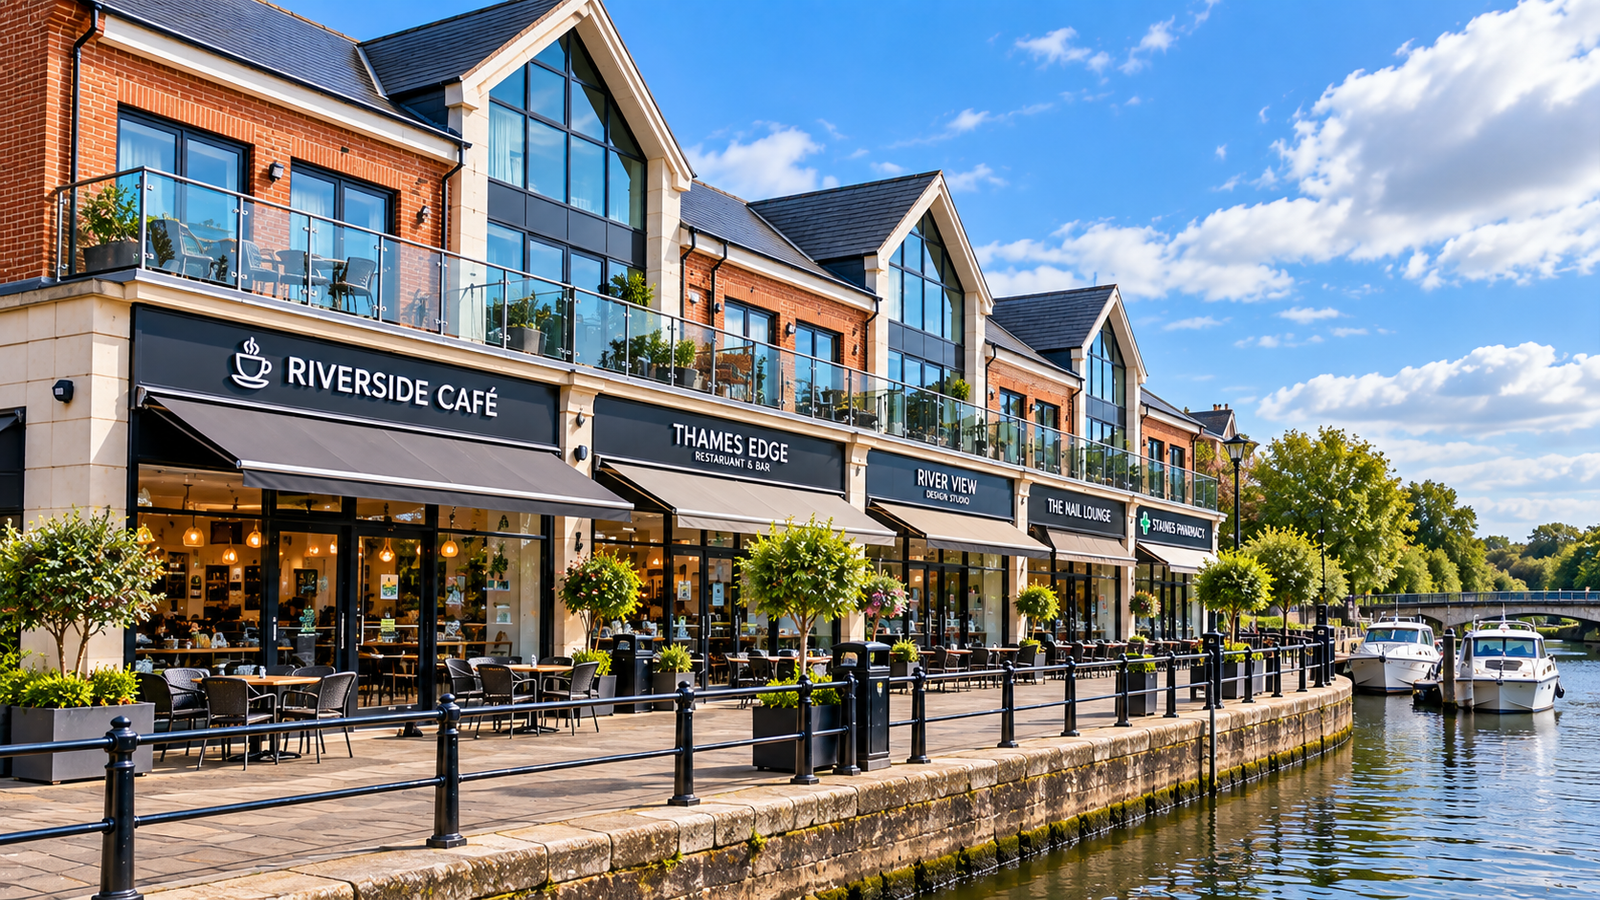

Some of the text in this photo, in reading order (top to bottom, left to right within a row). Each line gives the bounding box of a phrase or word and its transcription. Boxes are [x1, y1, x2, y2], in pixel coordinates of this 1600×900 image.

[288, 356, 498, 417] RIVERSIDE CAFÉ
[673, 423, 789, 463] THAMES EDGE
[747, 460, 753, 469] &
[755, 461, 771, 472] BAR
[917, 468, 978, 495] RIVER VIEW
[926, 490, 970, 505] DESIGN STUDIO
[1048, 498, 1111, 523] THE NAIL LOUNGE
